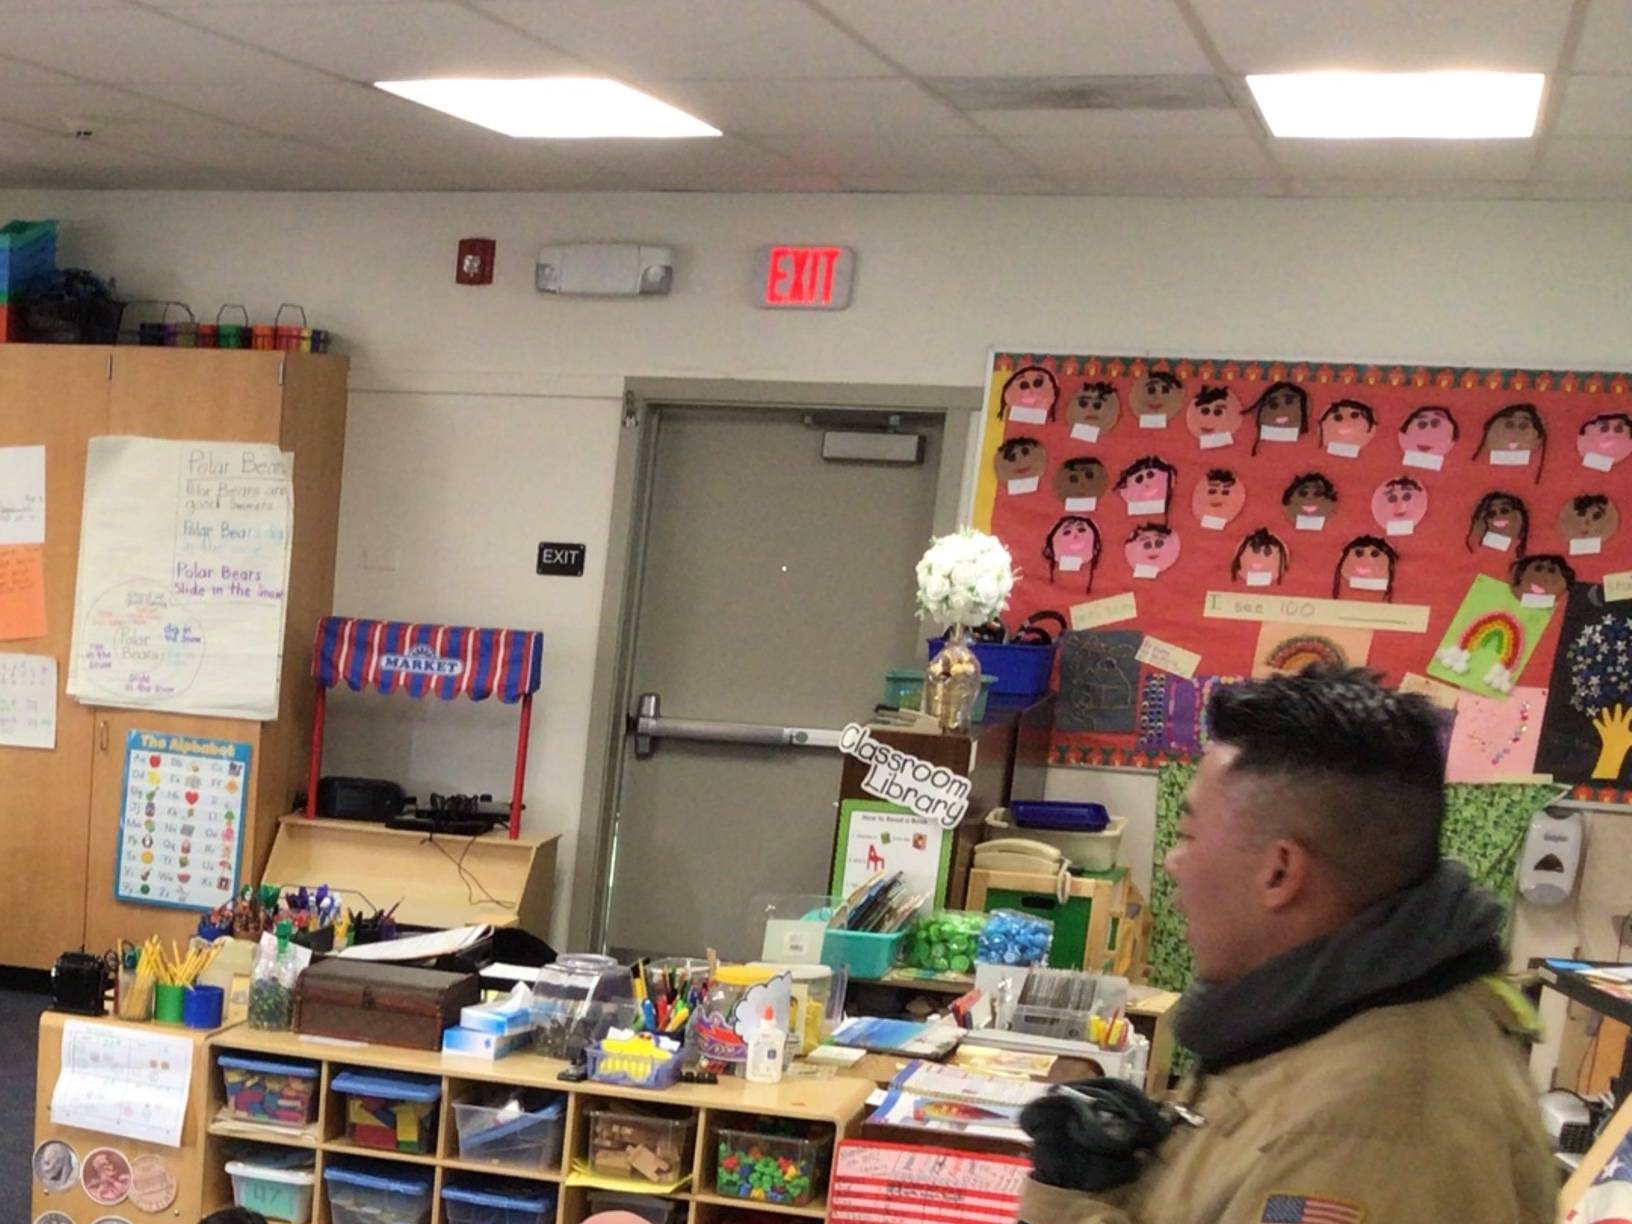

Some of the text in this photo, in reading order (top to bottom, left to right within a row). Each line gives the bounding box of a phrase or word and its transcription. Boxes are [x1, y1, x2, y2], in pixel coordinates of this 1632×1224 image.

[766, 247, 842, 304] EXIT
[188, 450, 230, 475] Polar
[183, 519, 214, 538] Polar
[543, 548, 580, 565] EXIT
[176, 562, 262, 582] Polar Bears
[212, 585, 224, 597] in
[230, 581, 251, 598] the
[1209, 594, 1316, 617] I see 100
[120, 626, 151, 647] Polar
[384, 656, 458, 673] MARKET
[141, 734, 235, 757] The Alphabet
[841, 725, 969, 798] Classroom
[865, 764, 964, 827] Library
[886, 816, 904, 824] Read
